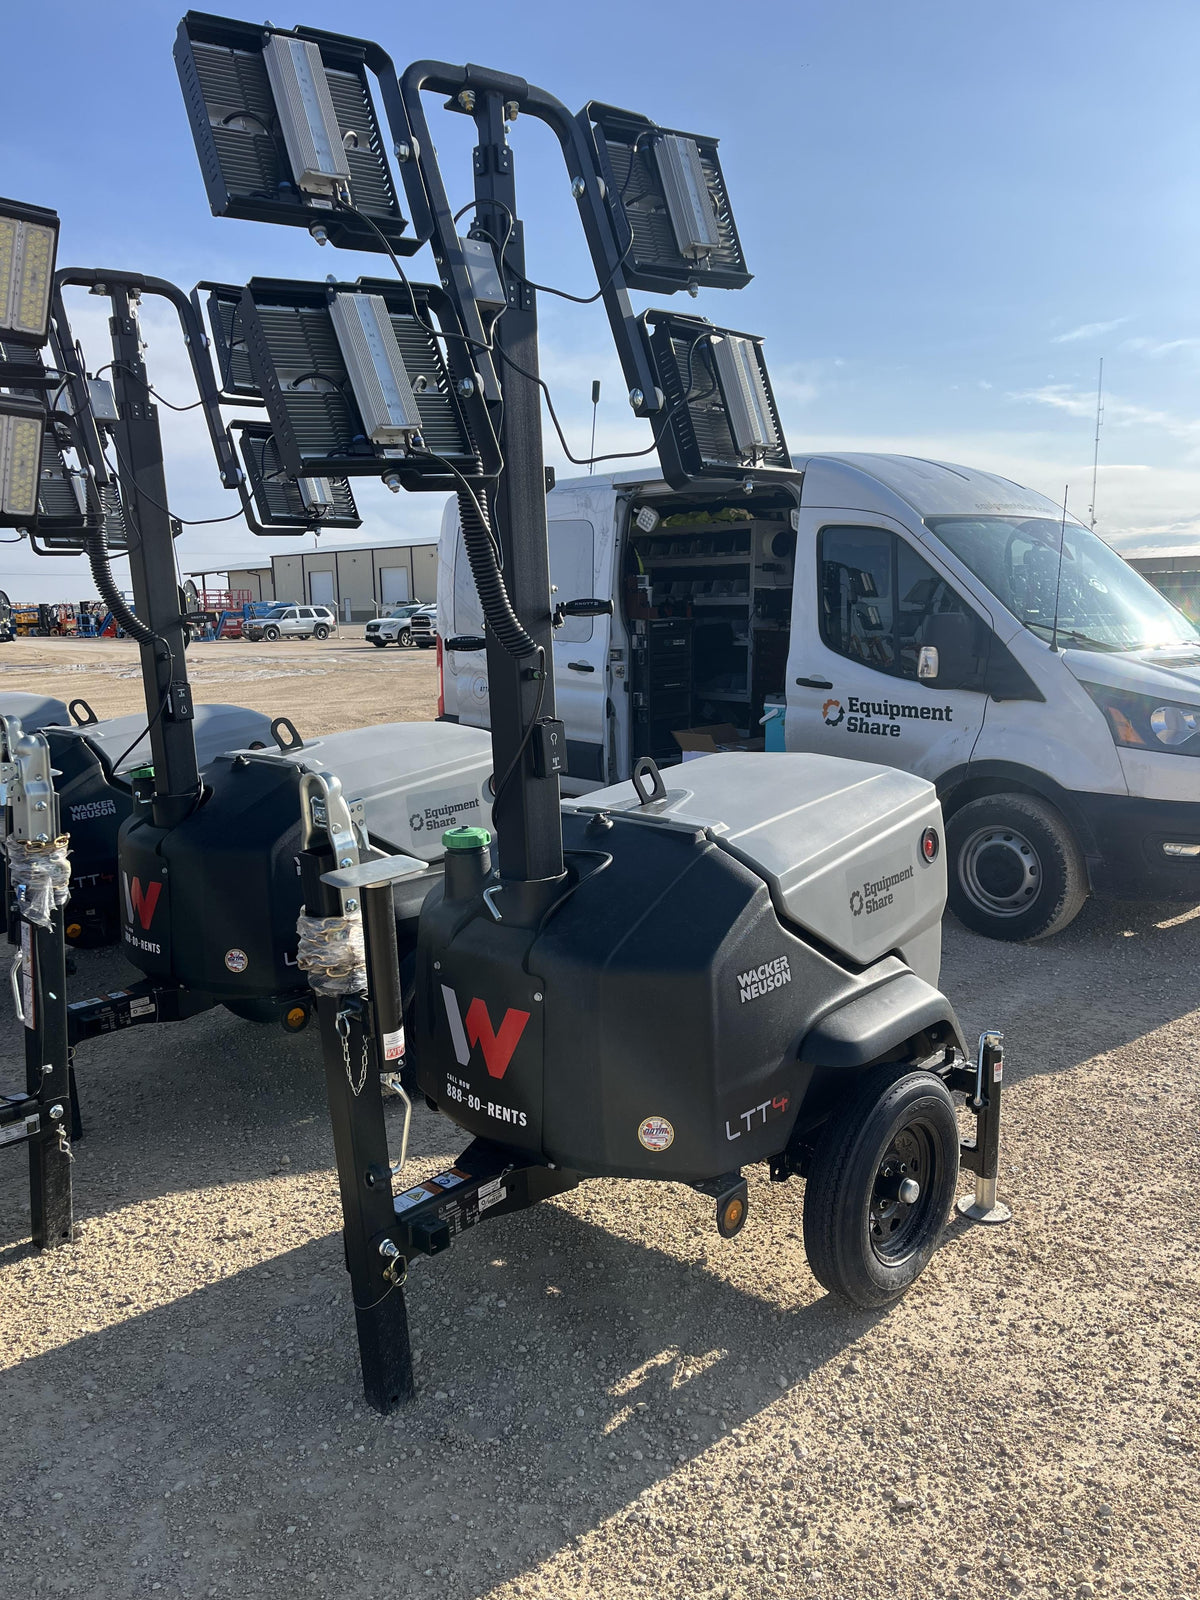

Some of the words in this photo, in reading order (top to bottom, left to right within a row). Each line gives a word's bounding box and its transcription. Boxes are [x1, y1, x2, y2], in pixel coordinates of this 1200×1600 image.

[848, 697, 953, 722] Equipment
[847, 716, 901, 737] Share
[69, 800, 115, 814] WACKER
[71, 806, 117, 821] NEUSON
[424, 798, 480, 819] Equipment
[426, 817, 457, 831] Share
[863, 865, 914, 898] Equipment
[865, 893, 894, 915] Share
[736, 955, 790, 988] WACKER
[740, 968, 791, 1003] NEUSON
[446, 1072, 458, 1084] CALL
[446, 1082, 528, 1127] 888-80-RENTS
